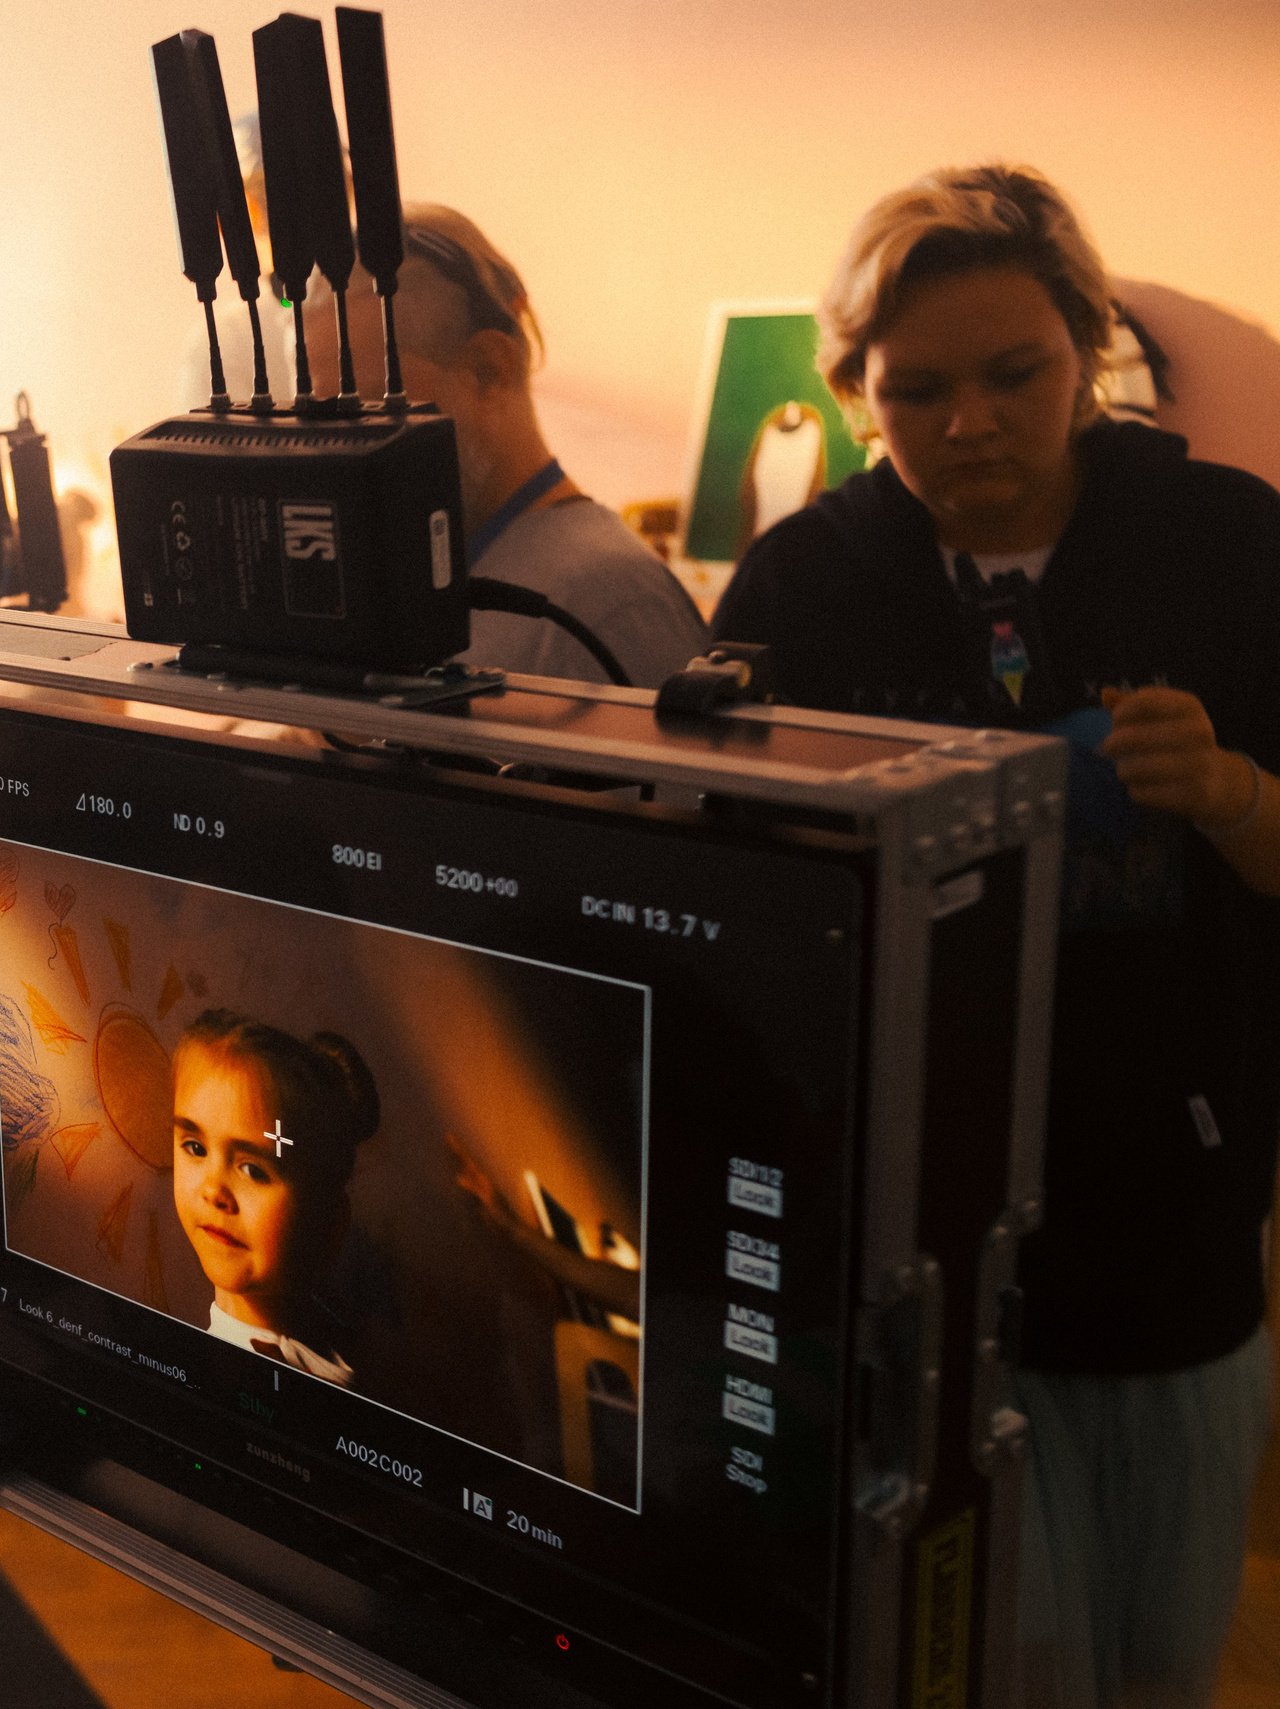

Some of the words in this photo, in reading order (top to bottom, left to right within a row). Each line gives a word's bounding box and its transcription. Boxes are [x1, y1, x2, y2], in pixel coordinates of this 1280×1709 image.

[282, 505, 337, 561] LKS
[7, 779, 30, 797] FPS
[173, 813, 191, 831] ND
[195, 817, 225, 838] 0.9
[581, 896, 610, 918] DC
[643, 907, 697, 937] 13.7
[703, 920, 721, 941] V
[19, 1299, 45, 1319] Look
[335, 1436, 424, 1488] A002C002
